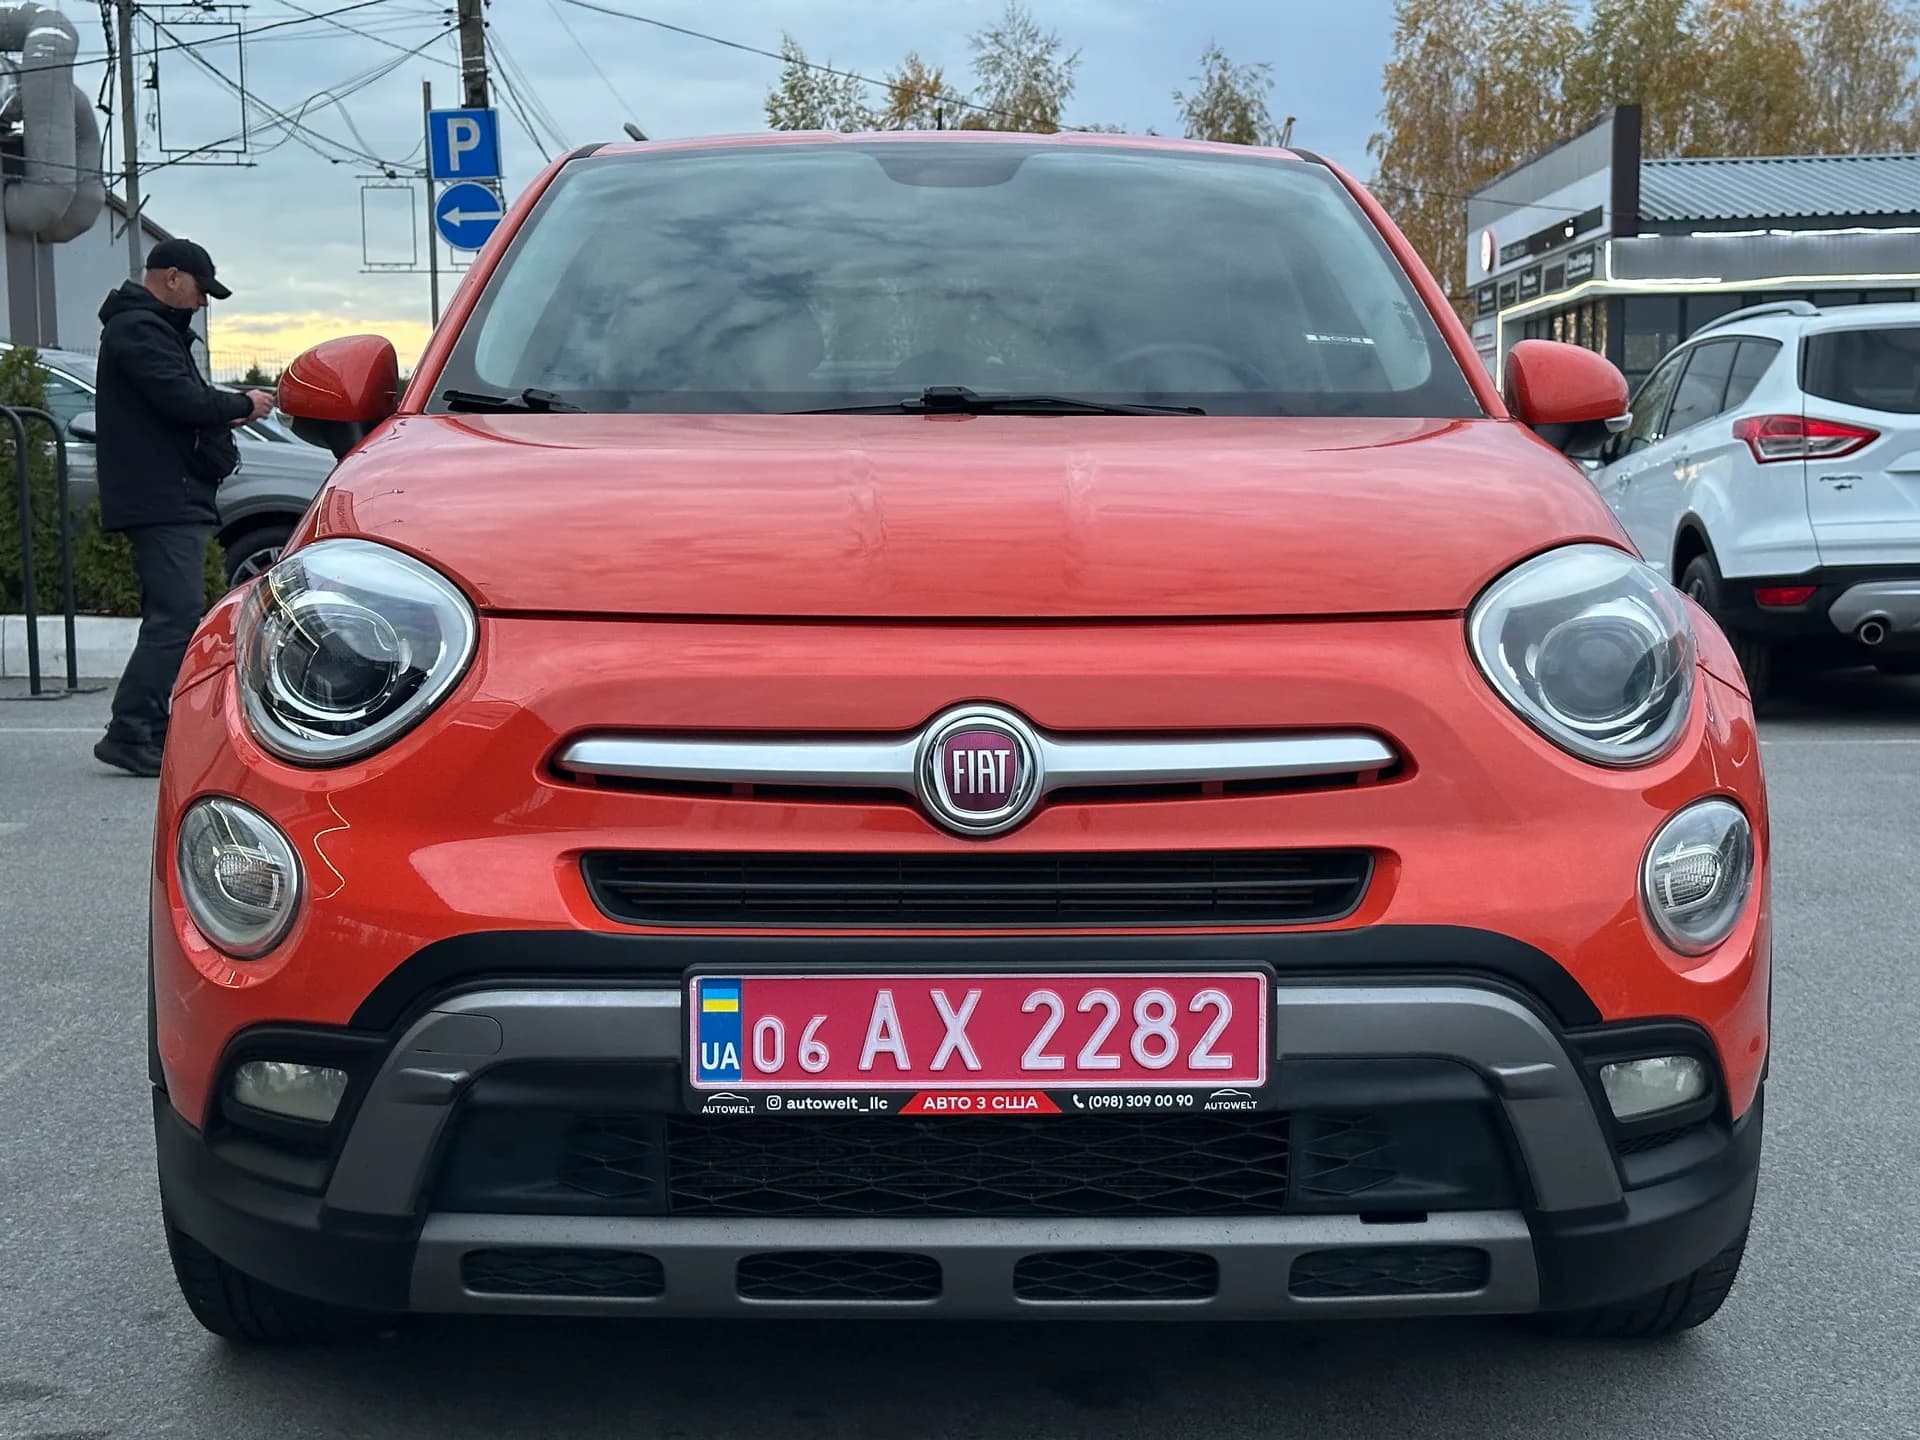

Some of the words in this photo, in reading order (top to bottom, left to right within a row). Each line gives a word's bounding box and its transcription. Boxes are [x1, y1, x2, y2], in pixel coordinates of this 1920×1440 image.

[447, 117, 481, 171] P
[953, 749, 1010, 794] FIAT
[752, 1015, 829, 1073] 06
[858, 989, 983, 1072] AX
[1021, 989, 1233, 1070] 2282
[701, 1042, 740, 1070] UA
[702, 1105, 756, 1114] AUTOWELT
[786, 1096, 889, 1112] autowelt_llc
[923, 1096, 972, 1110] АВТО
[992, 1095, 1039, 1110] США
[1088, 1095, 1123, 1110] (098)
[1126, 1095, 1151, 1107] 309
[1154, 1095, 1173, 1107] 00
[1176, 1094, 1194, 1107] 90
[1204, 1101, 1258, 1110] AUTOWELT
